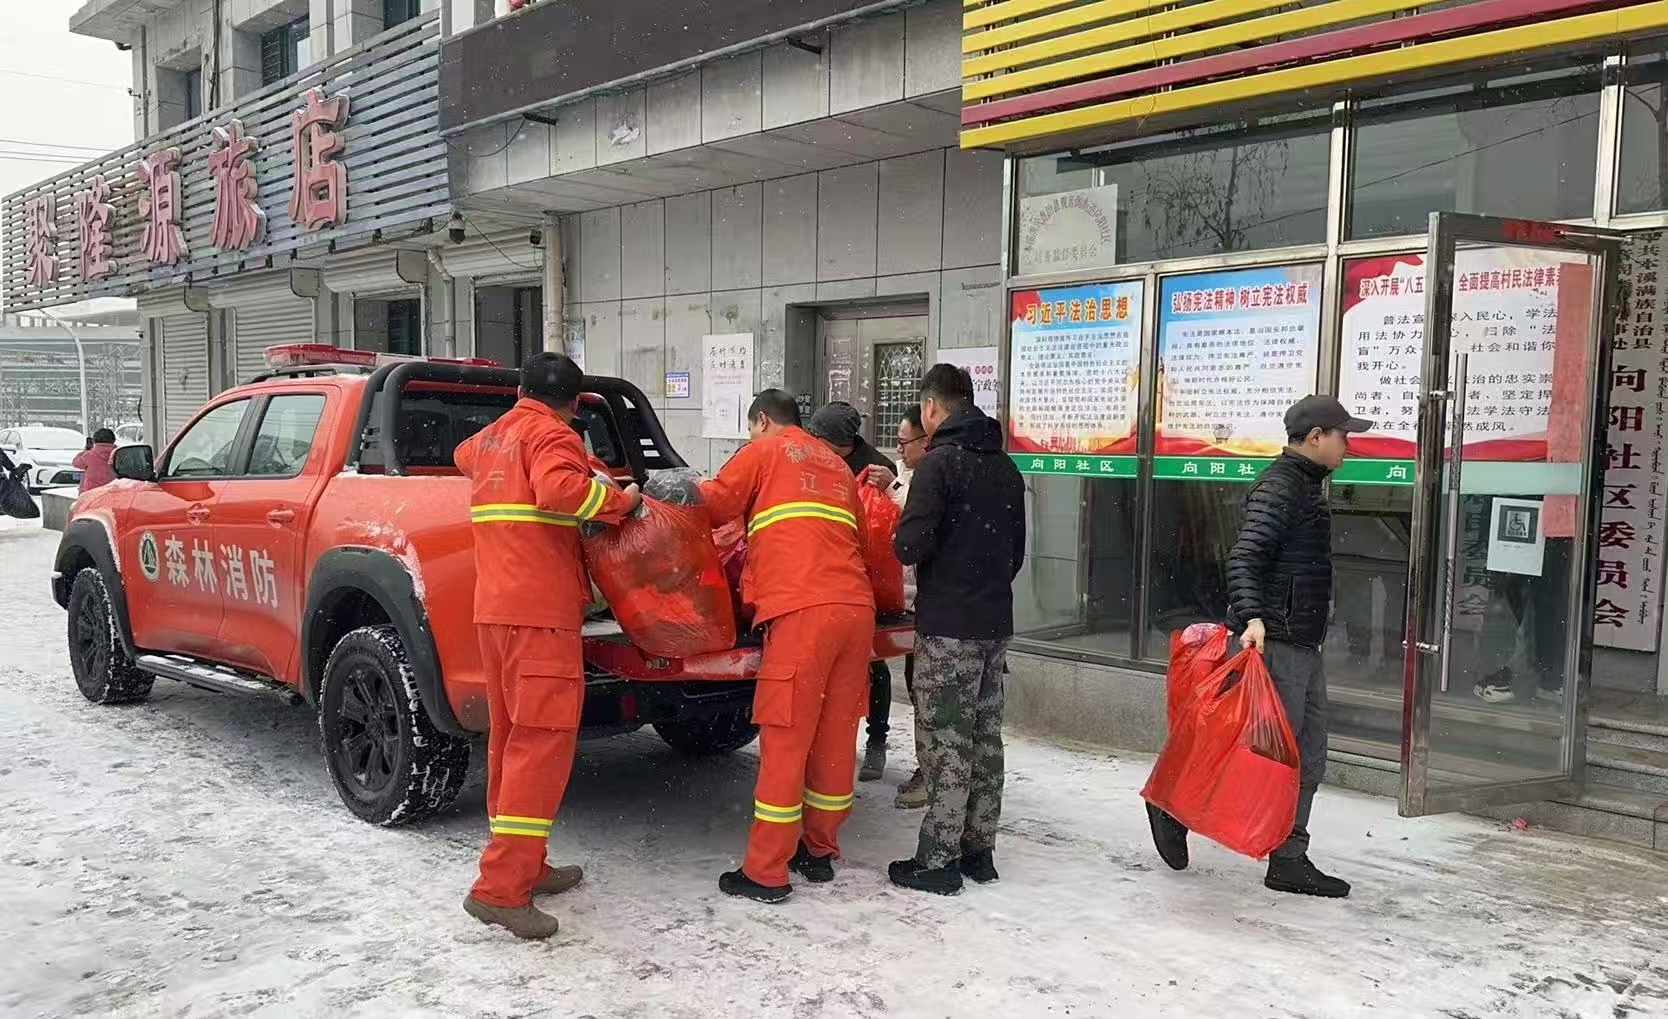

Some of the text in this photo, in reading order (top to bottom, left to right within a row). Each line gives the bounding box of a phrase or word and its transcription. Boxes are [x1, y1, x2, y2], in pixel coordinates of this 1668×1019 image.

[26, 88, 350, 287] 聚隆源旅店
[1026, 296, 1129, 325] 习近平法治思想
[1173, 283, 1308, 311] 弘扬宪法精神 树立宪法权威
[1030, 458, 1114, 472] 向阳社区
[1182, 461, 1256, 475] 向阳社
[1386, 465, 1406, 479] 向
[1593, 365, 1648, 628] 向阳社区委员会
[164, 534, 279, 609] 森林消防
